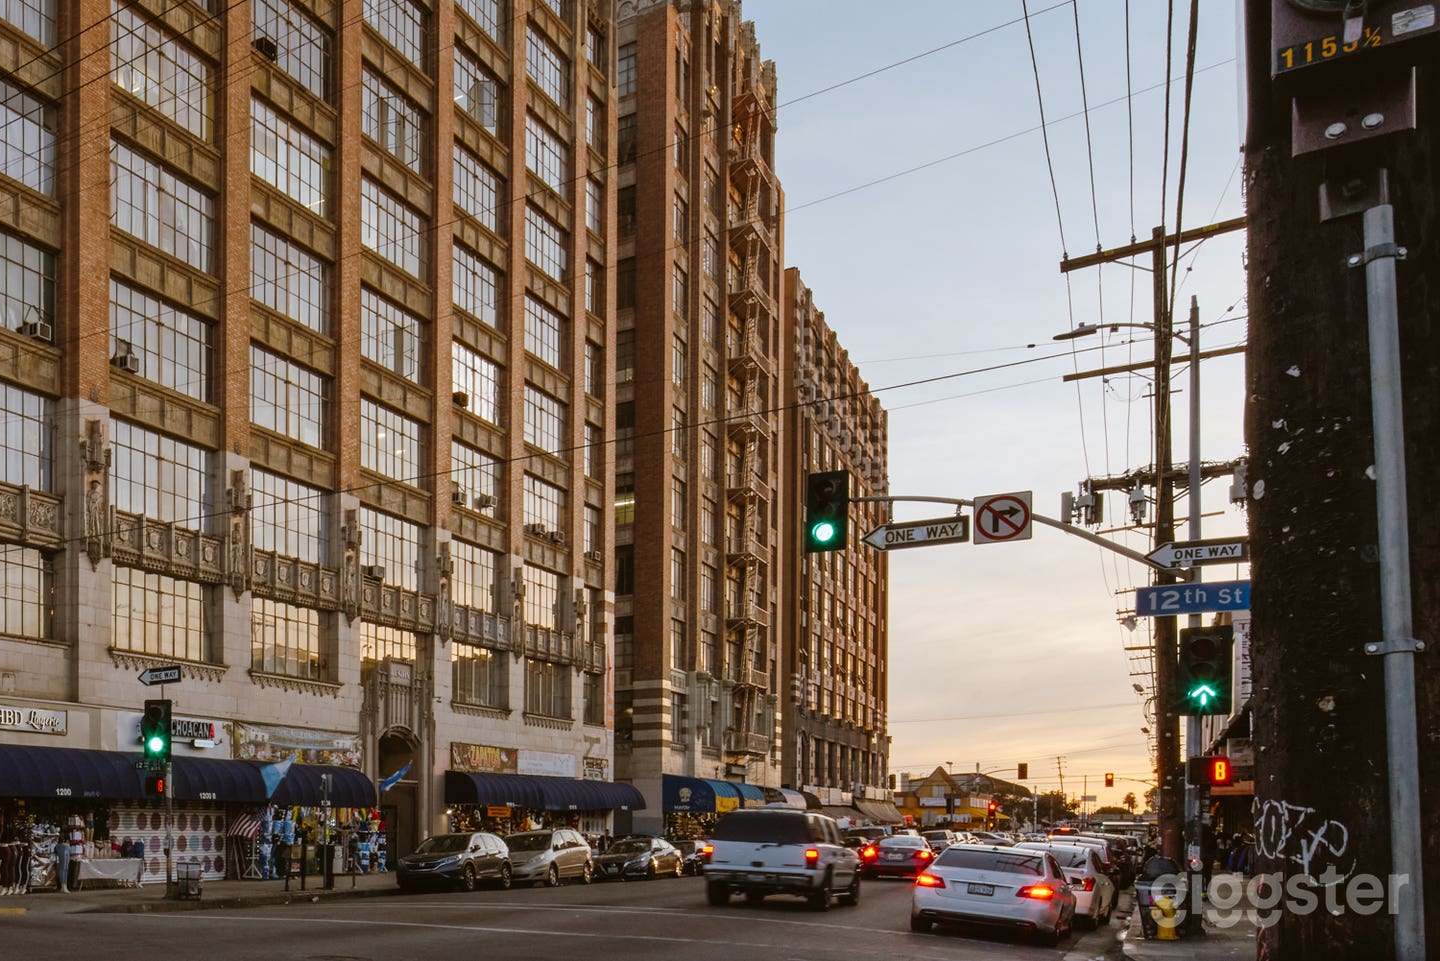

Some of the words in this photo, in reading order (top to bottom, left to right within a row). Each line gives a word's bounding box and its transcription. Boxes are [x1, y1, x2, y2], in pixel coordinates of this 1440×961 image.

[885, 527, 920, 544] ONE
[925, 522, 959, 538] WAY
[1174, 548, 1203, 560] ONE
[1208, 545, 1238, 557] WAY
[1148, 589, 1207, 611] 12th
[1218, 588, 1243, 604] St
[150, 671, 162, 680] ONE
[164, 670, 176, 679] WAY
[171, 720, 214, 738] CHOACANA
[56, 787, 71, 796] 1200
